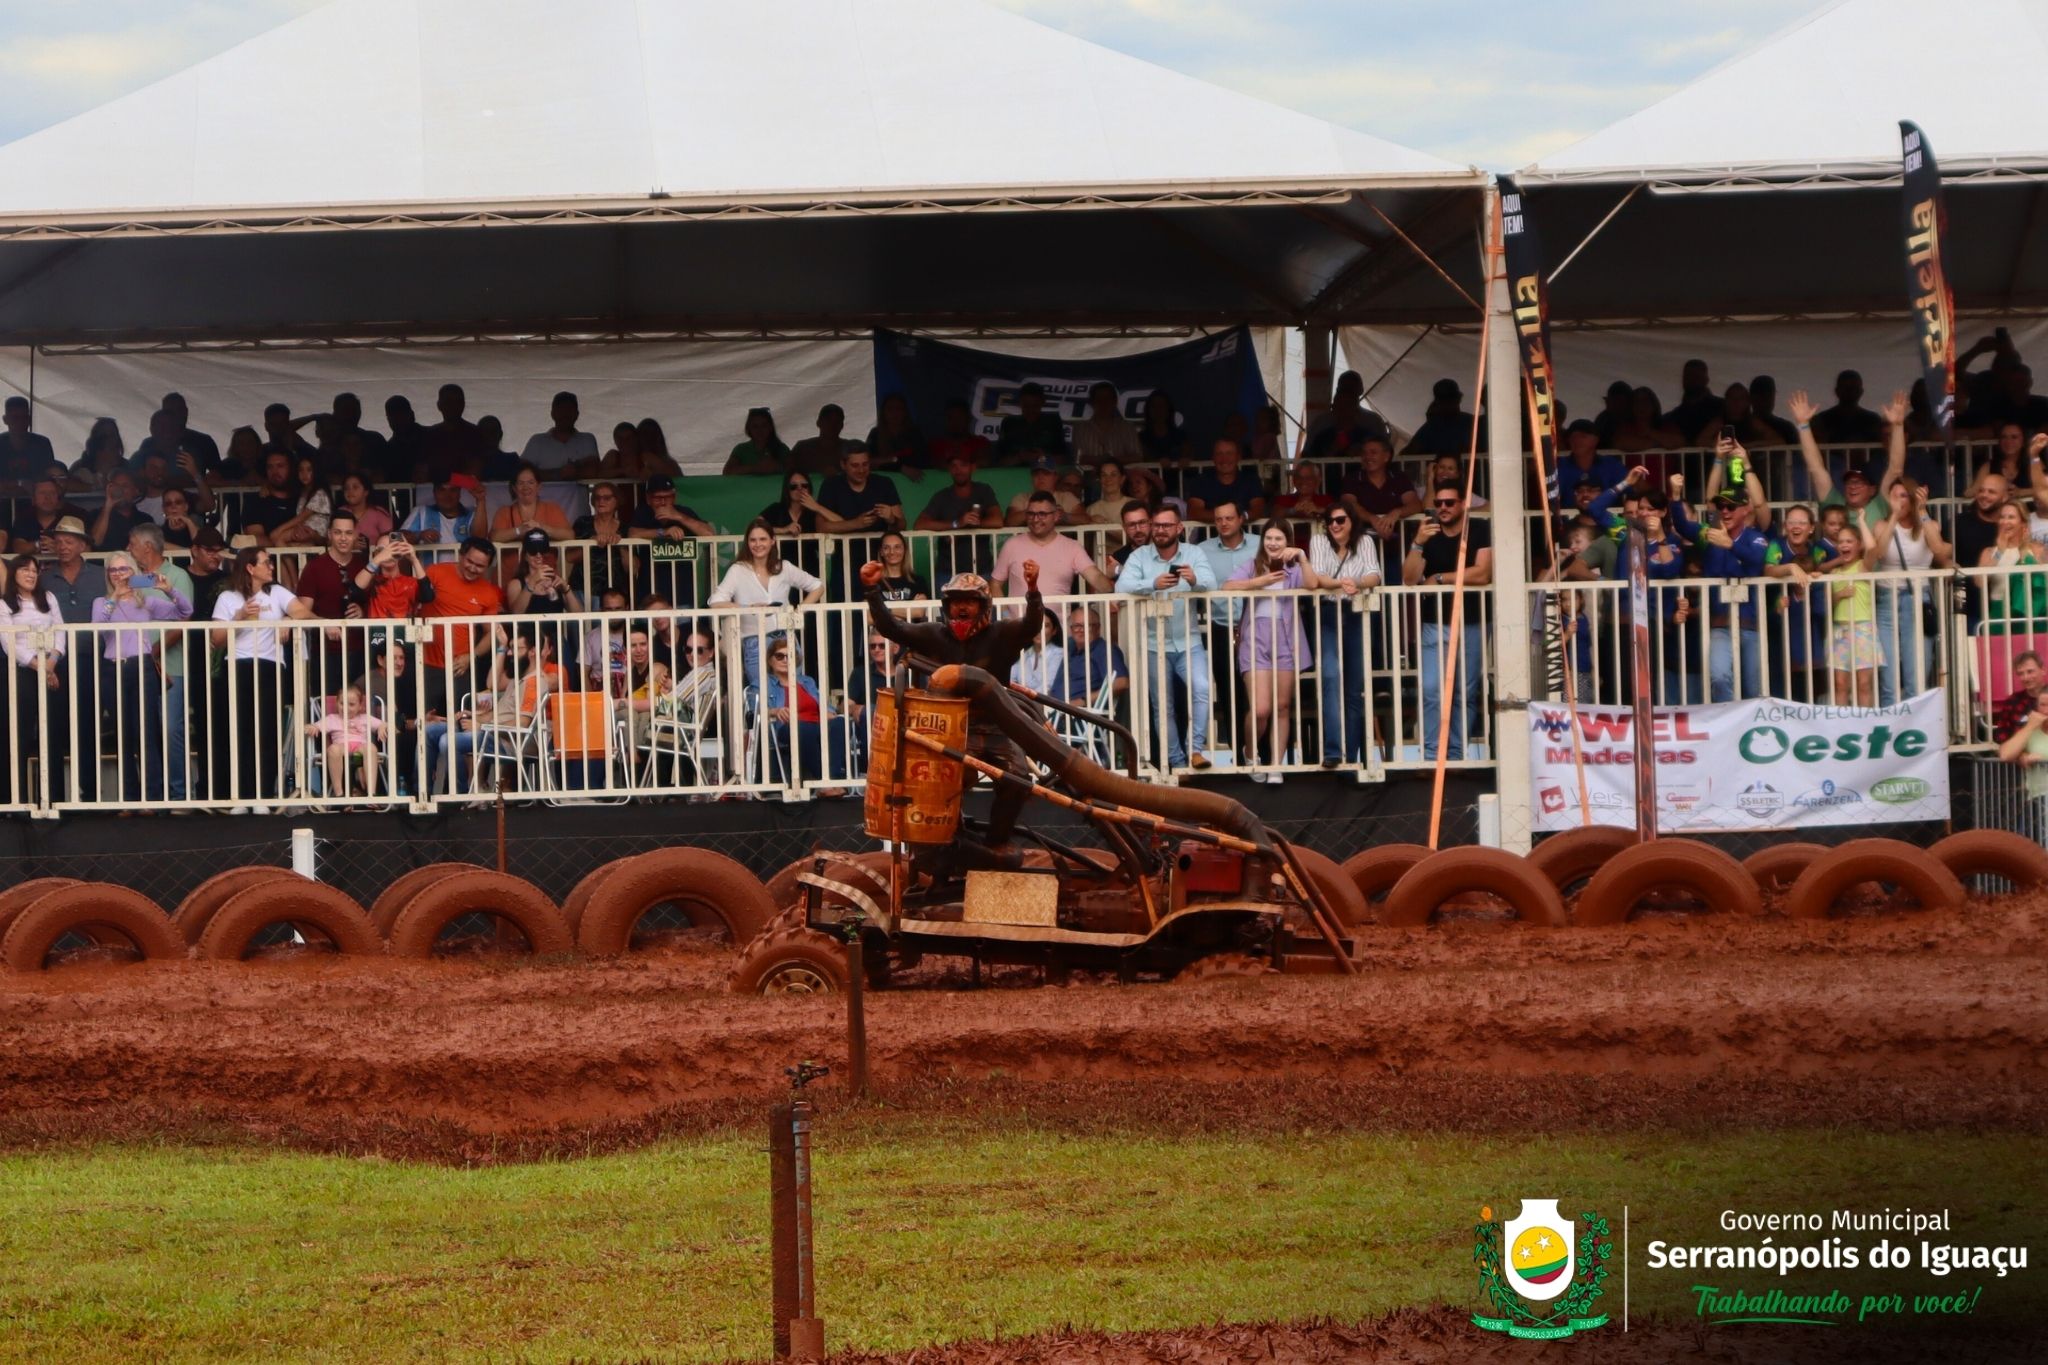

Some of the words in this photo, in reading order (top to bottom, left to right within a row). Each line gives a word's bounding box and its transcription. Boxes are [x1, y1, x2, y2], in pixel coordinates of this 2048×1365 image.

[1503, 193, 1521, 213] AQUI
[1504, 214, 1524, 235] TEM!
[652, 542, 682, 556] SAÍDA
[1738, 725, 1929, 764] Oeste
